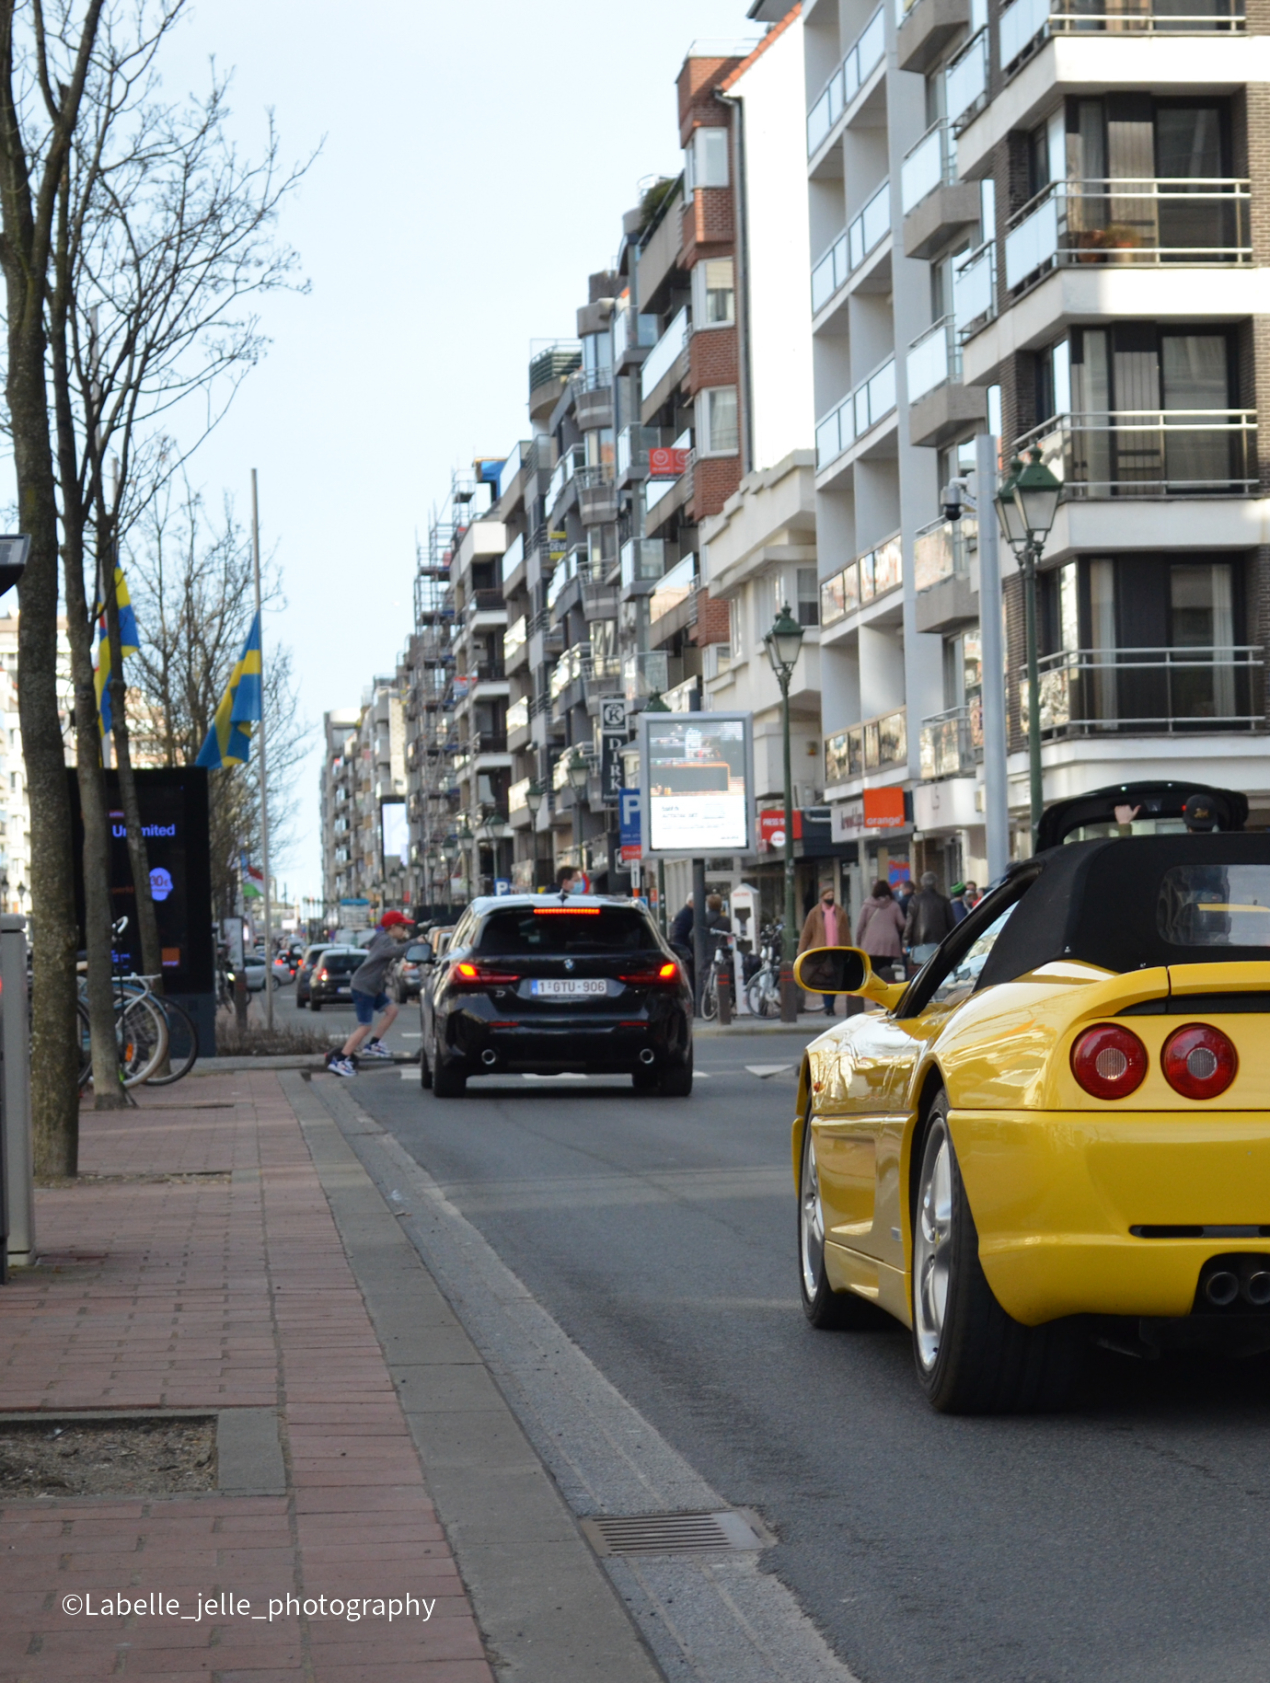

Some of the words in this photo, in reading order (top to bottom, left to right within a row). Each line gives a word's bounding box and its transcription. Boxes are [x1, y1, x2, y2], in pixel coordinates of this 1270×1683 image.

[608, 738, 622, 790] DIRK
[866, 815, 901, 826] orange
[496, 881, 509, 896] P
